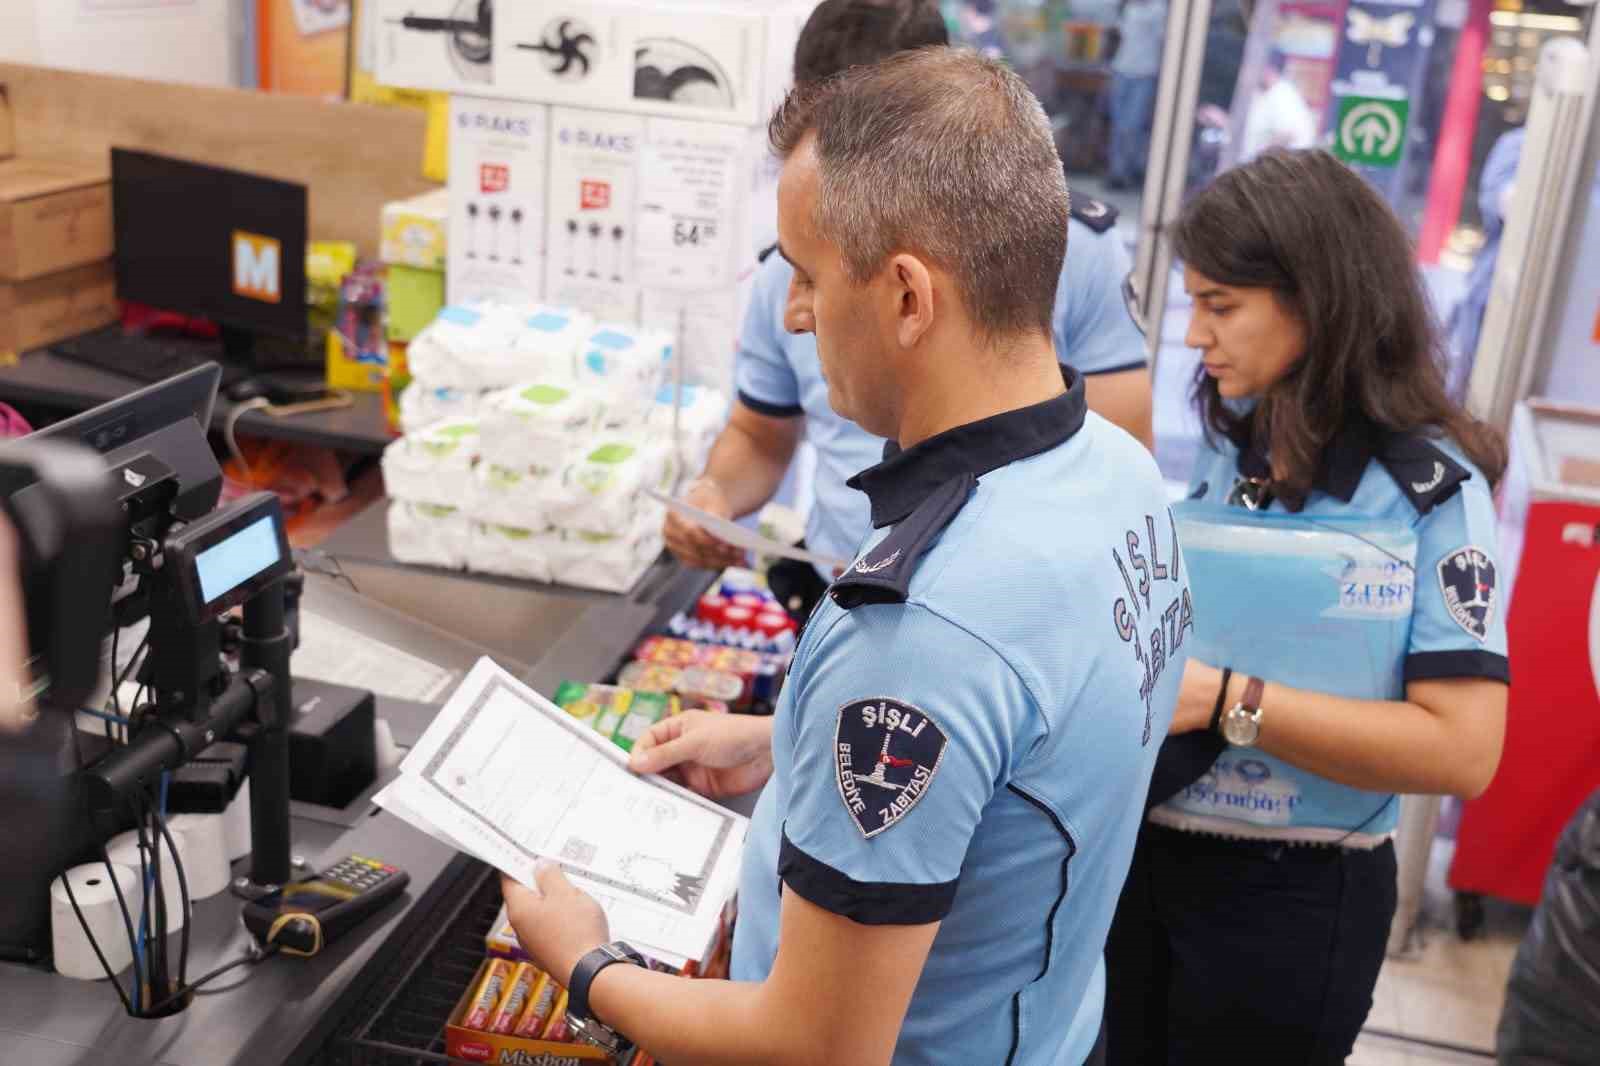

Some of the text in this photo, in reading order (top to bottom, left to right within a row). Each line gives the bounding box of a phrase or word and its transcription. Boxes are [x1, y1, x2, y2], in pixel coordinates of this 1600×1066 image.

[235, 237, 279, 294] M
[861, 702, 928, 738] ŞİŞLİ
[838, 742, 867, 816] BELEDİYE
[878, 764, 931, 824] ZABITASI
